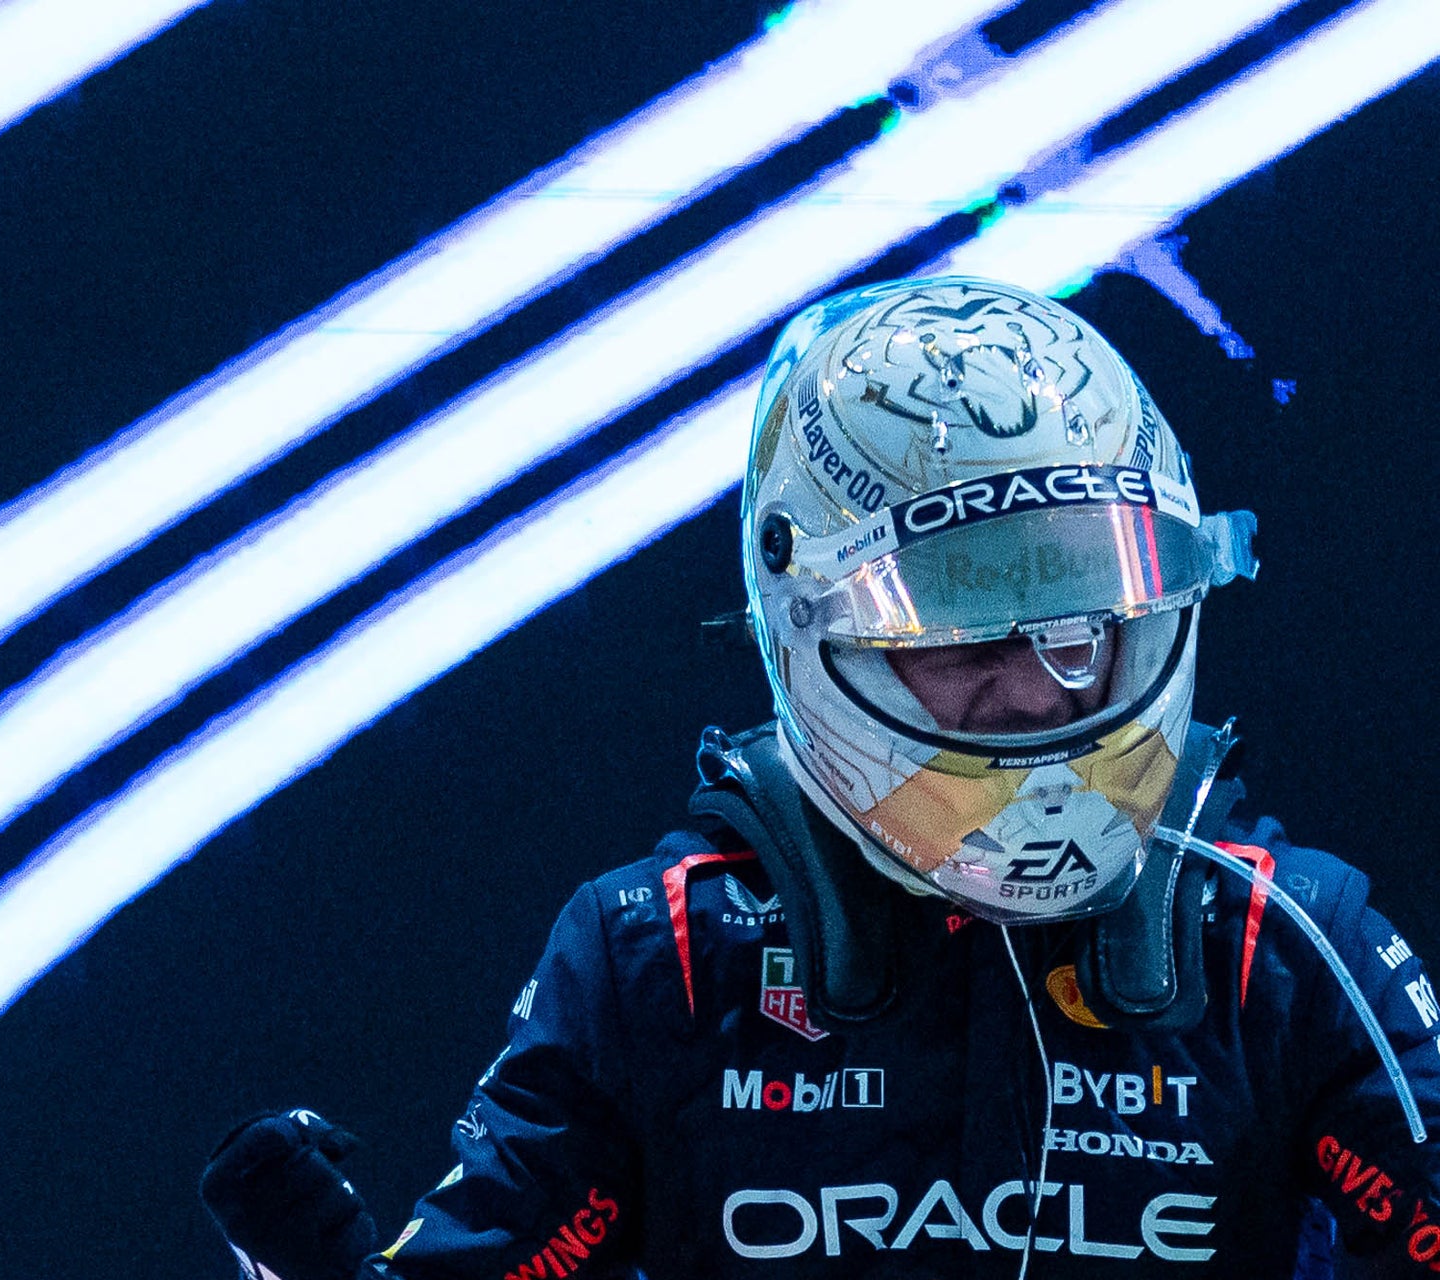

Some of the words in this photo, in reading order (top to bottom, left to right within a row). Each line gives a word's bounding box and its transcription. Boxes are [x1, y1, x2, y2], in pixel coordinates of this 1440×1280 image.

[799, 397, 852, 485] Player
[904, 467, 1149, 534] ORACLE
[837, 531, 871, 563] Mobil
[1004, 838, 1098, 883] EA
[998, 874, 1097, 901] SPORTS
[722, 1069, 837, 1112] Mobil
[1053, 1062, 1197, 1117] BYBIT
[1044, 1128, 1213, 1165] HONDA
[1317, 1135, 1394, 1222] GIVES
[722, 1180, 1218, 1261] ORACLE
